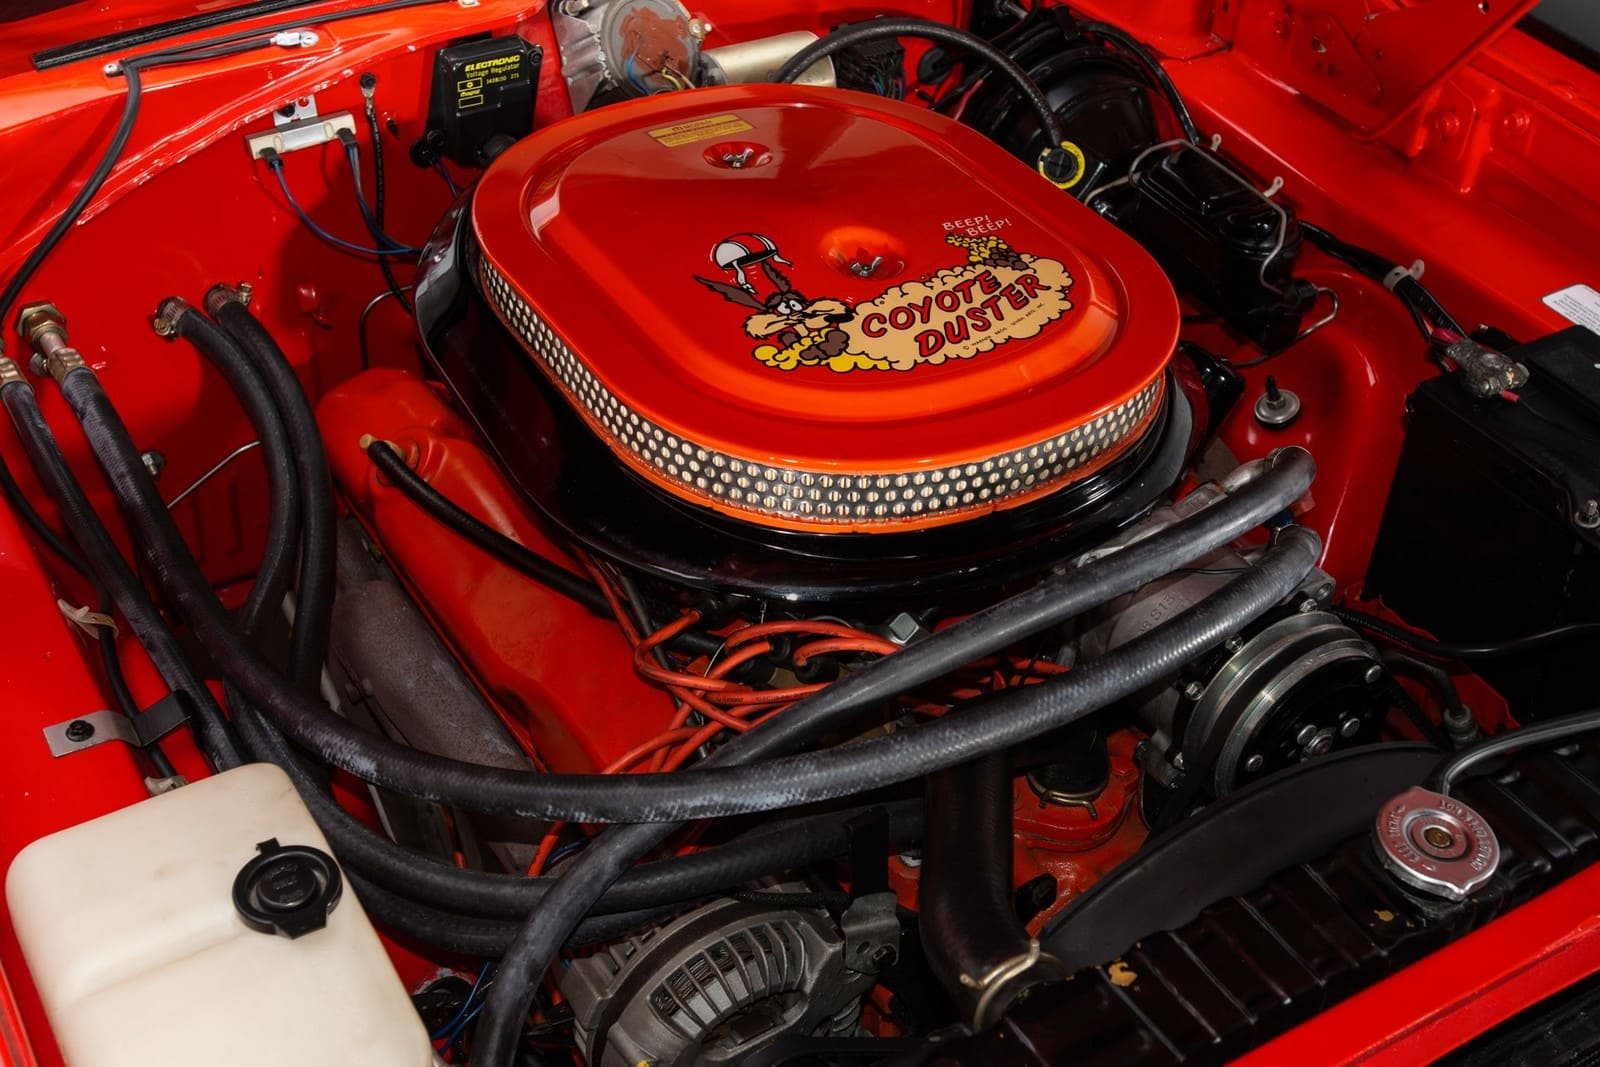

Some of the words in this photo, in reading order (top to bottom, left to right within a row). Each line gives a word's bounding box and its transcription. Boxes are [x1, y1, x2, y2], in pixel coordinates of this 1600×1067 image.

[465, 55, 520, 72] ELECTRONIC
[466, 70, 489, 78] Voltage
[491, 63, 520, 73] Regulator
[942, 214, 990, 231] BEEP!
[966, 218, 1012, 237] BEEP!
[861, 269, 1002, 338] COYOTE
[914, 274, 1052, 358] DUSTER
